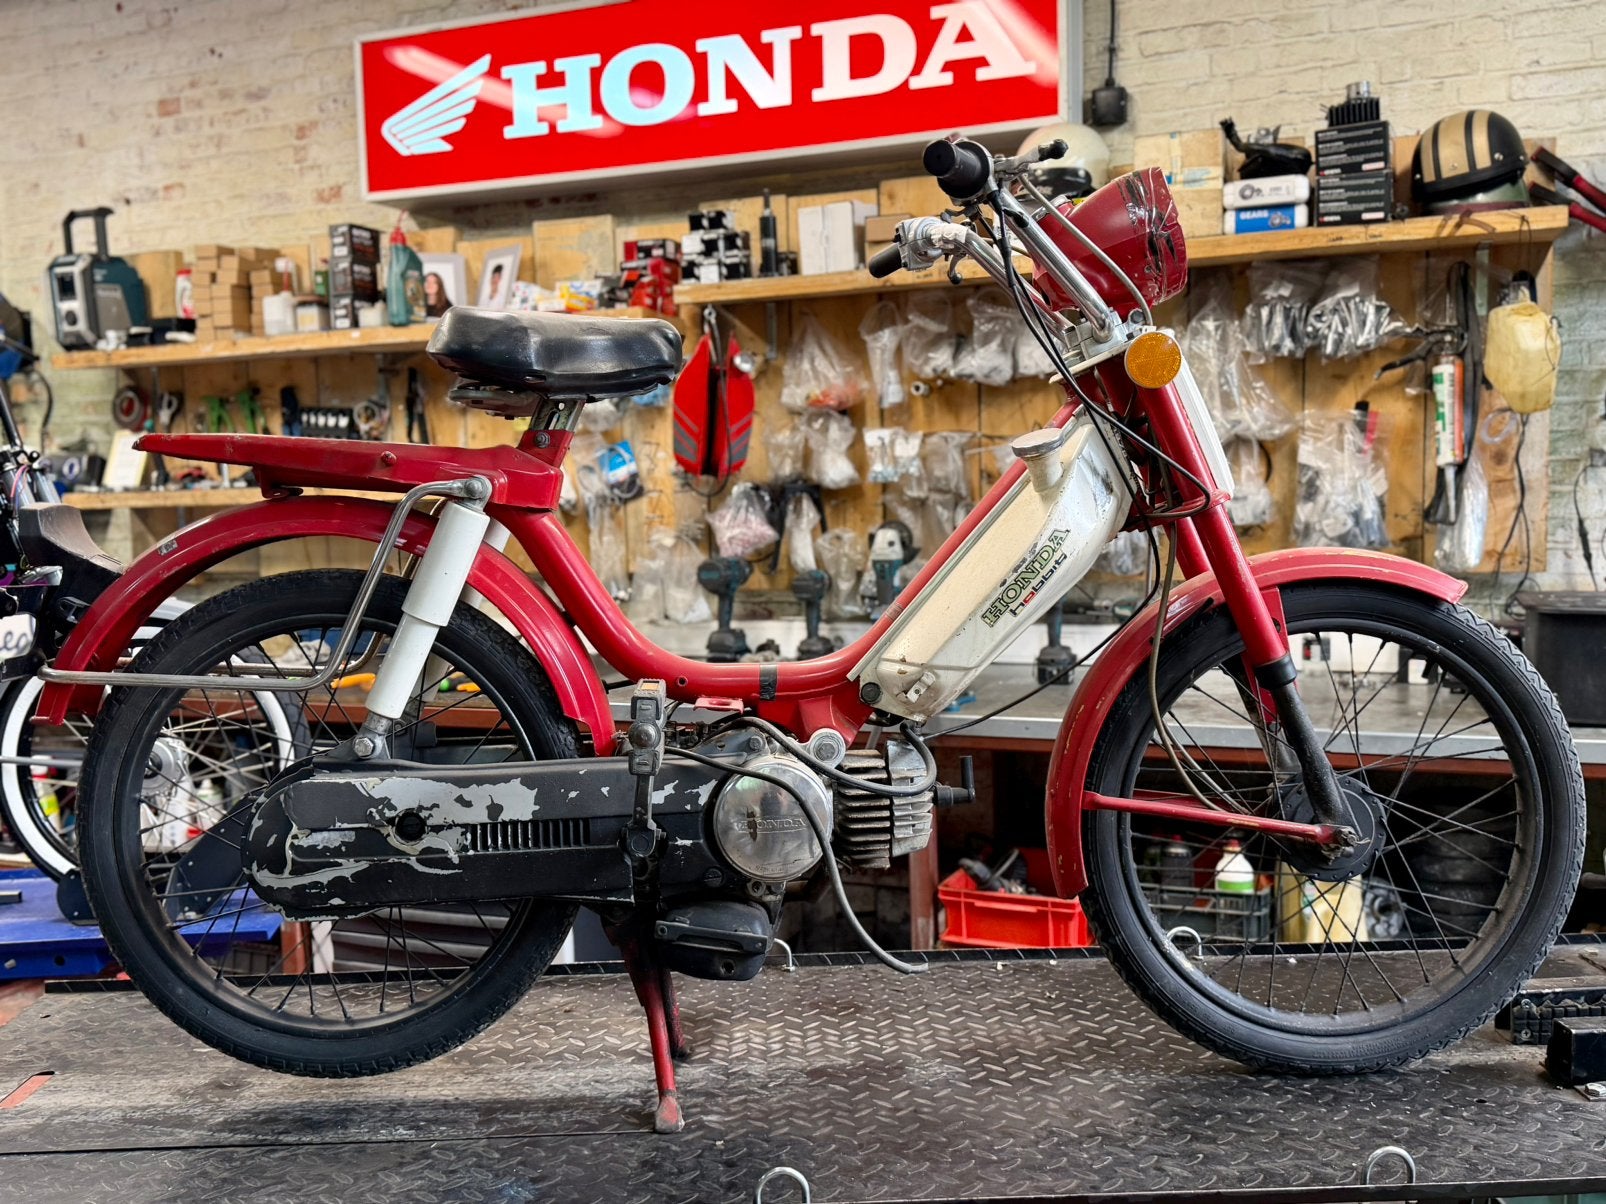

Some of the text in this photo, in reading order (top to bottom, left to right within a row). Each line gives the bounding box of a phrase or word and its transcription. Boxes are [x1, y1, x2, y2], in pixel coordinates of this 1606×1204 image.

[502, 0, 1037, 140] HONDA
[982, 529, 1070, 628] HONDA
[1010, 552, 1067, 617] hobbit
